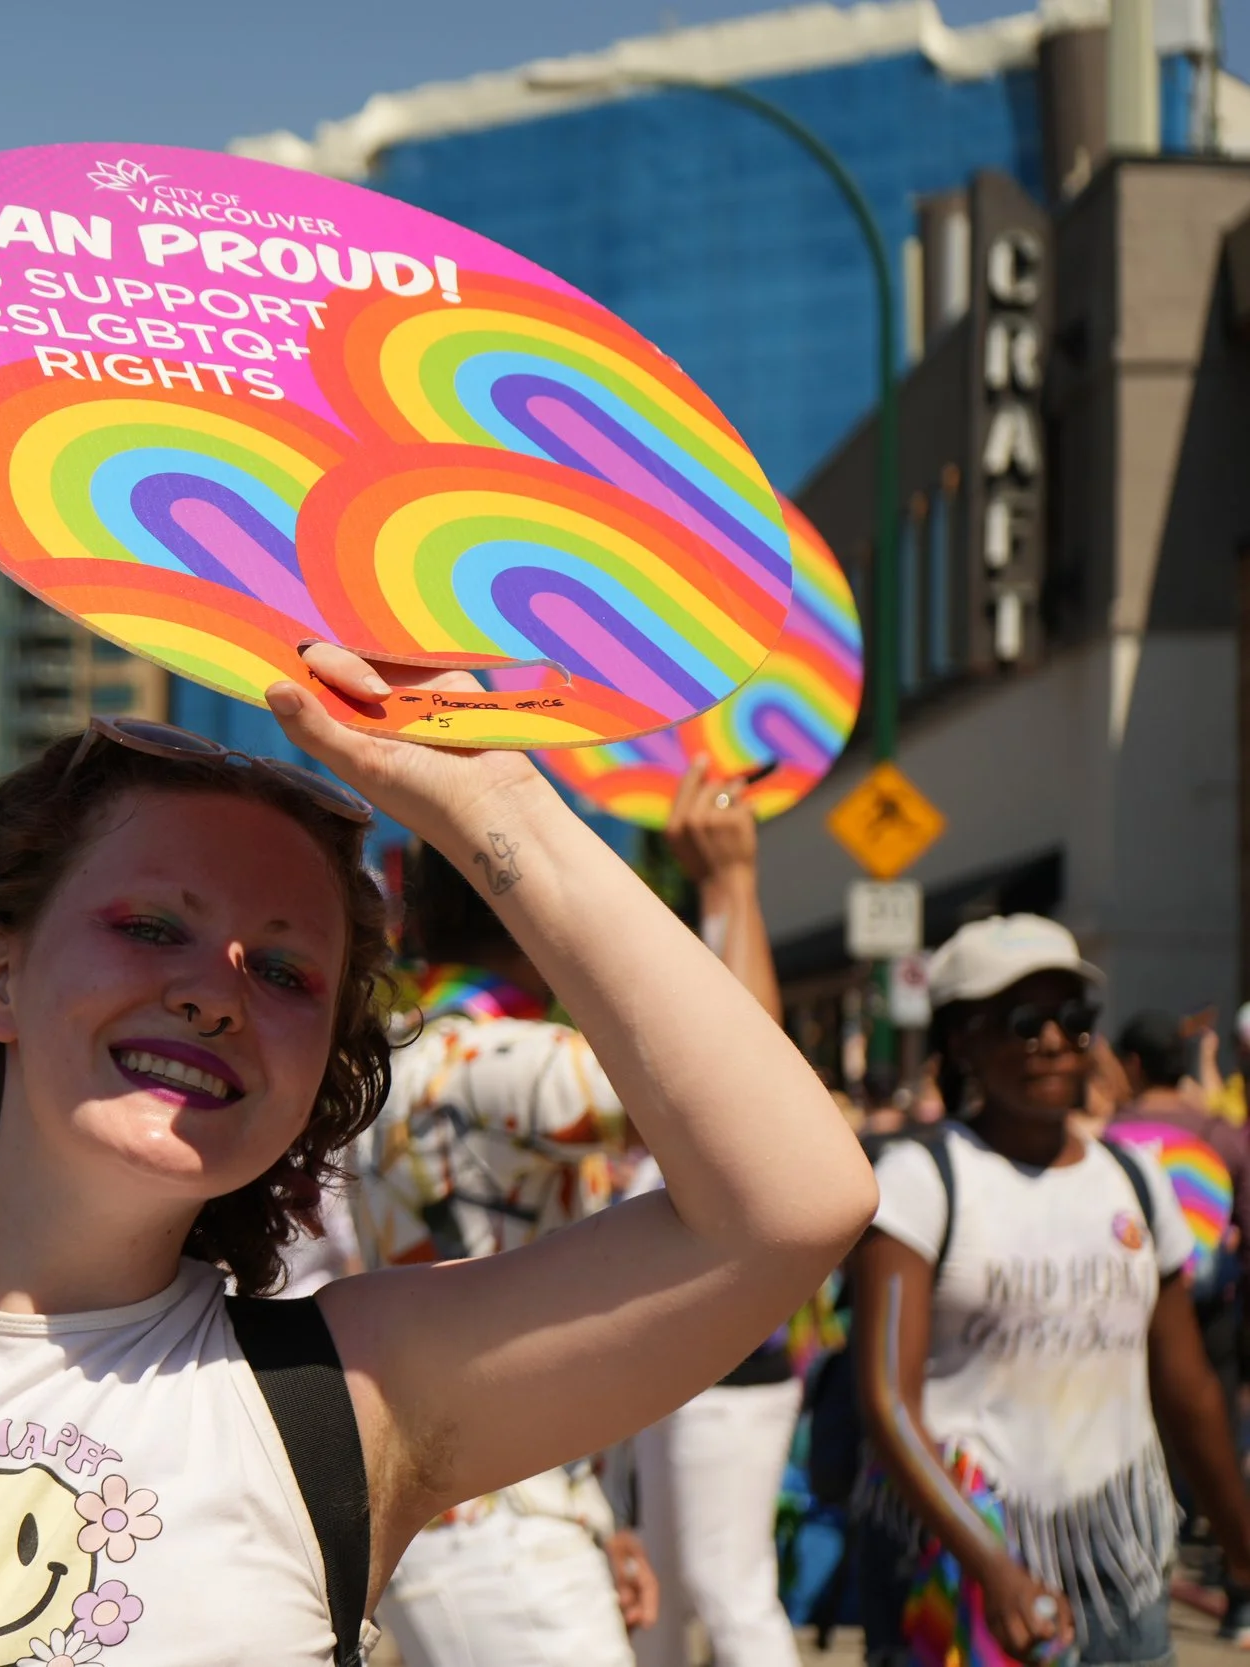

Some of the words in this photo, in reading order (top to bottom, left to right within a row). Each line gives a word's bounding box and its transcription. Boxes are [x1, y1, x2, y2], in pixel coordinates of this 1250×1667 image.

[127, 194, 342, 237] VANCOUVER
[154, 186, 203, 202] CITY
[211, 192, 240, 207] OF
[137, 223, 461, 305] PROUD!
[23, 268, 328, 329] SUPPORT
[33, 345, 285, 401] RIGHTS
